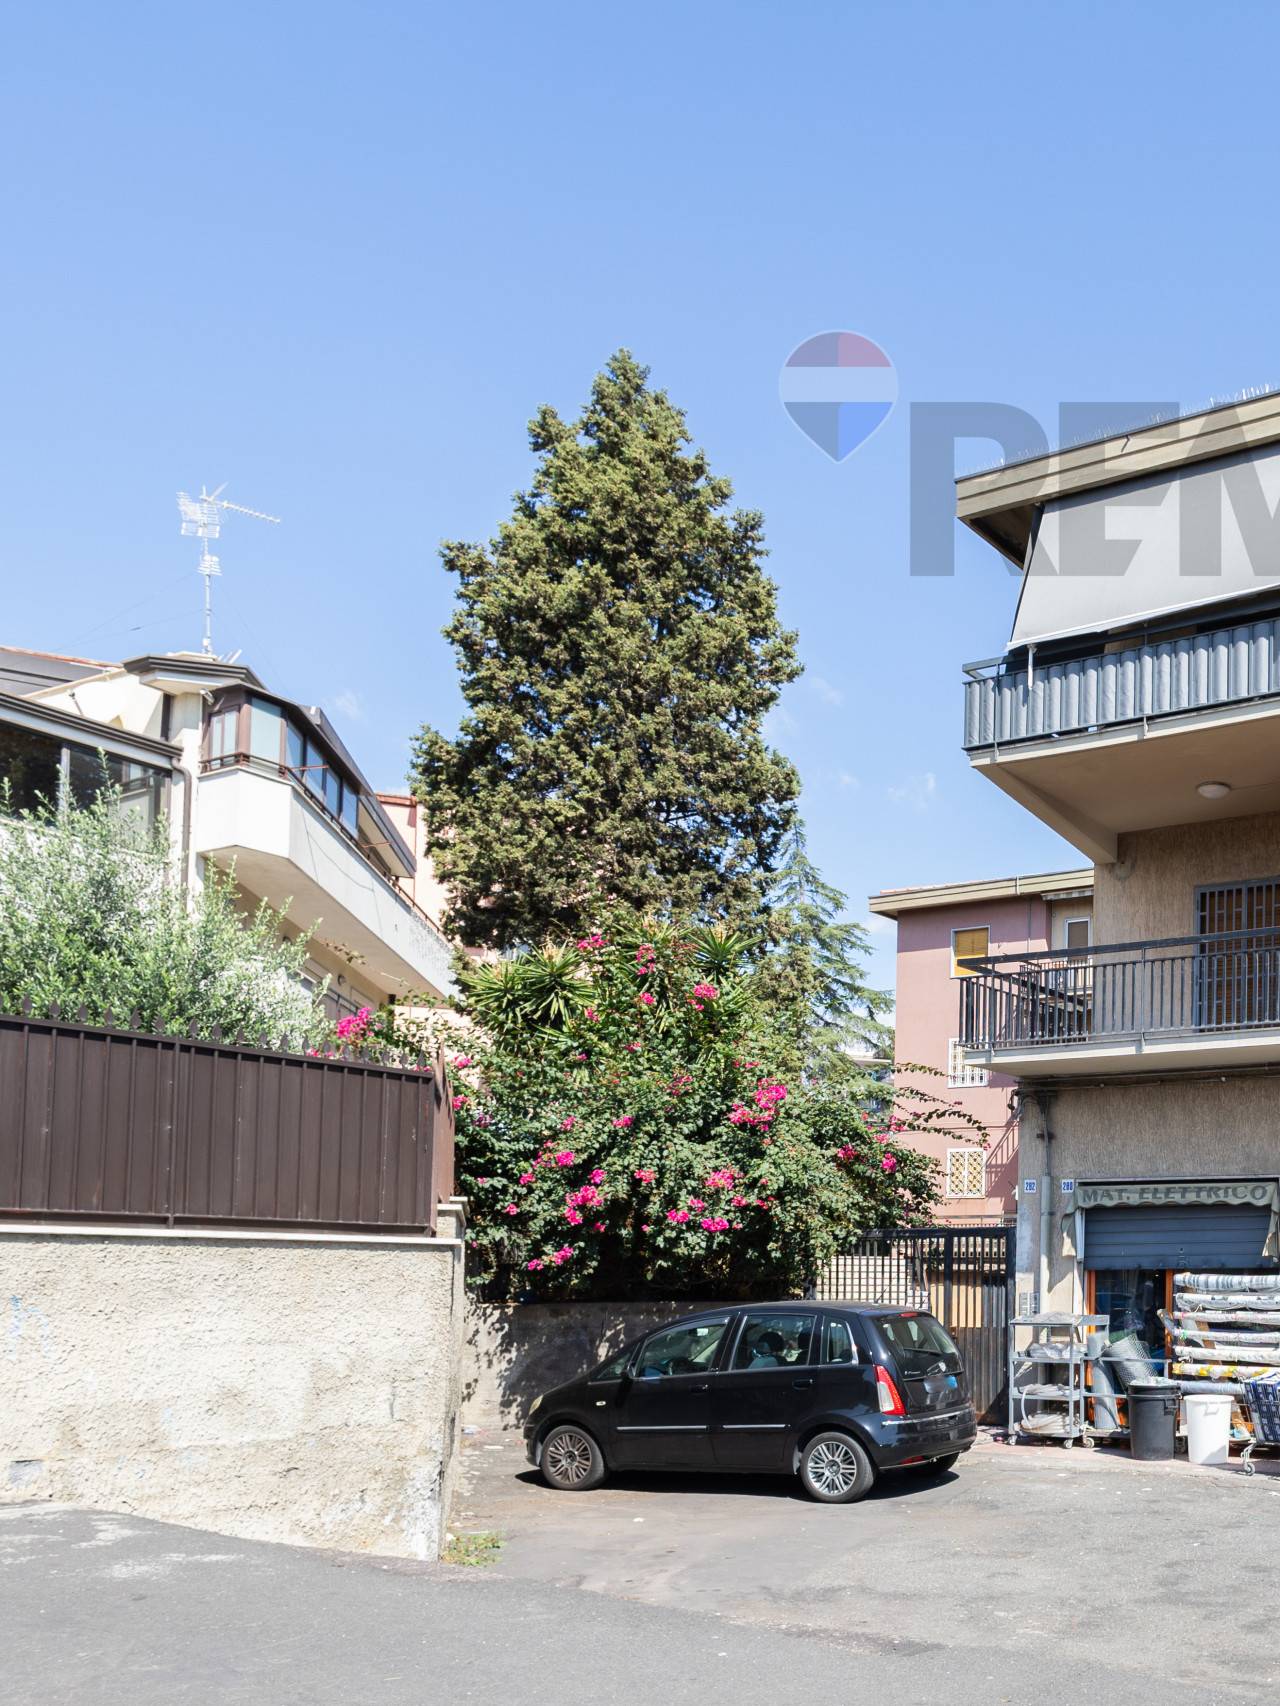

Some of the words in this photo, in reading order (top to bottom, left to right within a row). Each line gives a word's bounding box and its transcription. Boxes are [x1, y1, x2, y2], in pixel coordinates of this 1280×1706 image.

[1025, 1181, 1036, 1191] 282
[1082, 1188, 1130, 1203] MAT.
[1138, 1185, 1268, 1200] ELETTRICO
